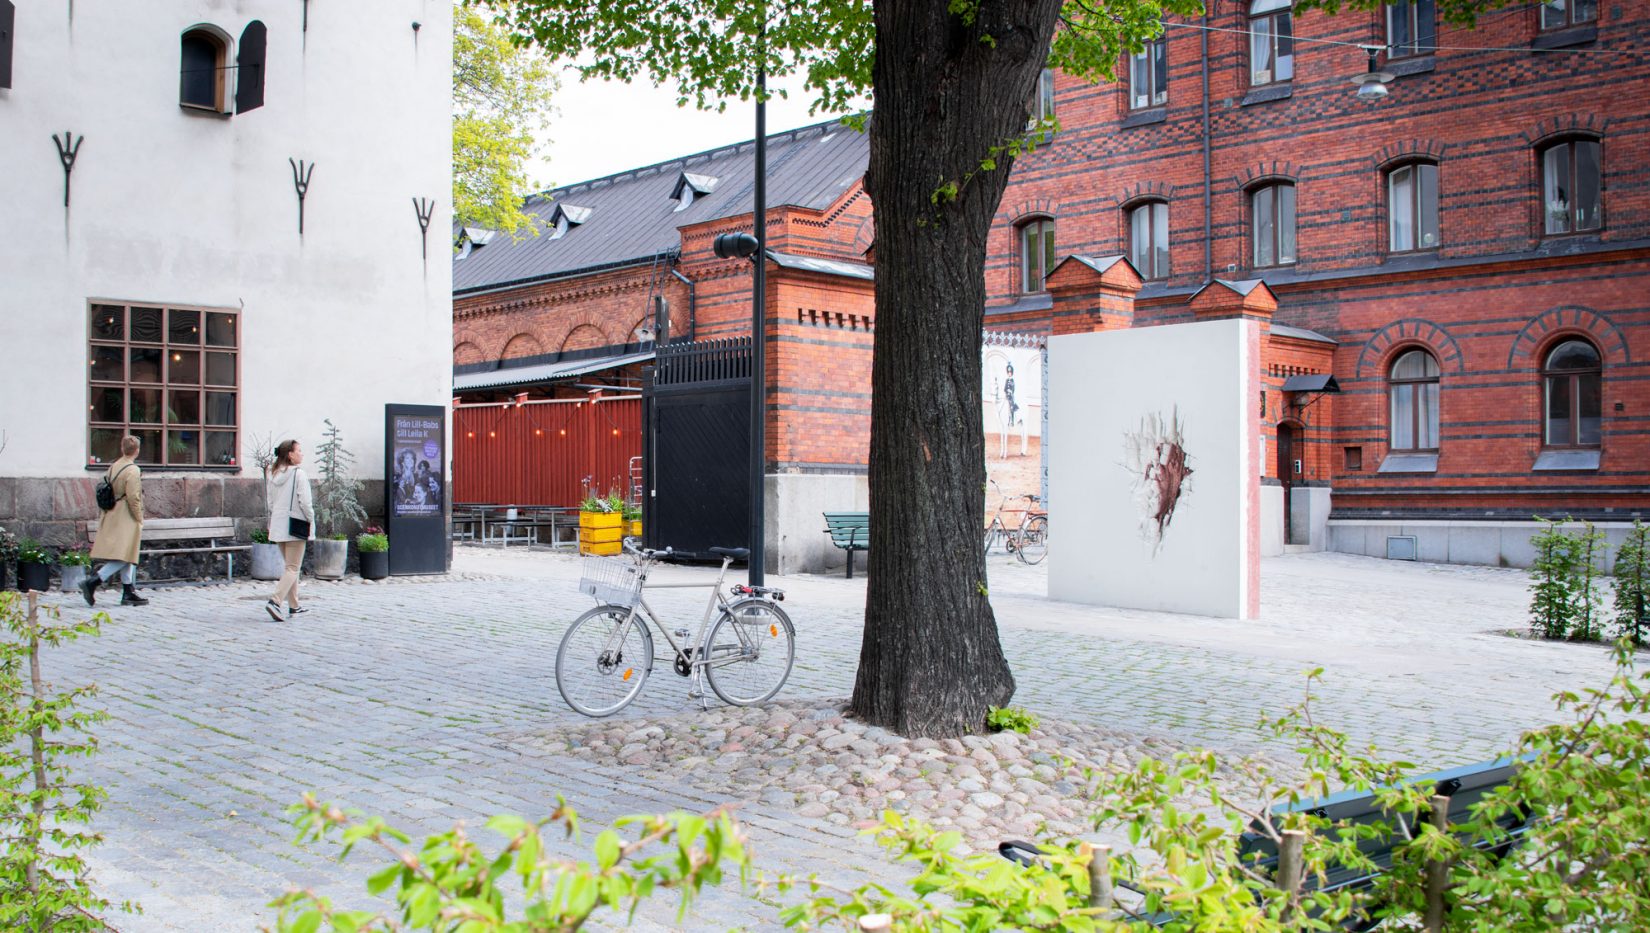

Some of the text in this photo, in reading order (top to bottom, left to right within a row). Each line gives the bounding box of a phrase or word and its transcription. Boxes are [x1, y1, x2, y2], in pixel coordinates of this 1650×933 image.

[397, 419, 439, 429] Från Lill-Babs
[397, 429, 429, 438] till Leila K
